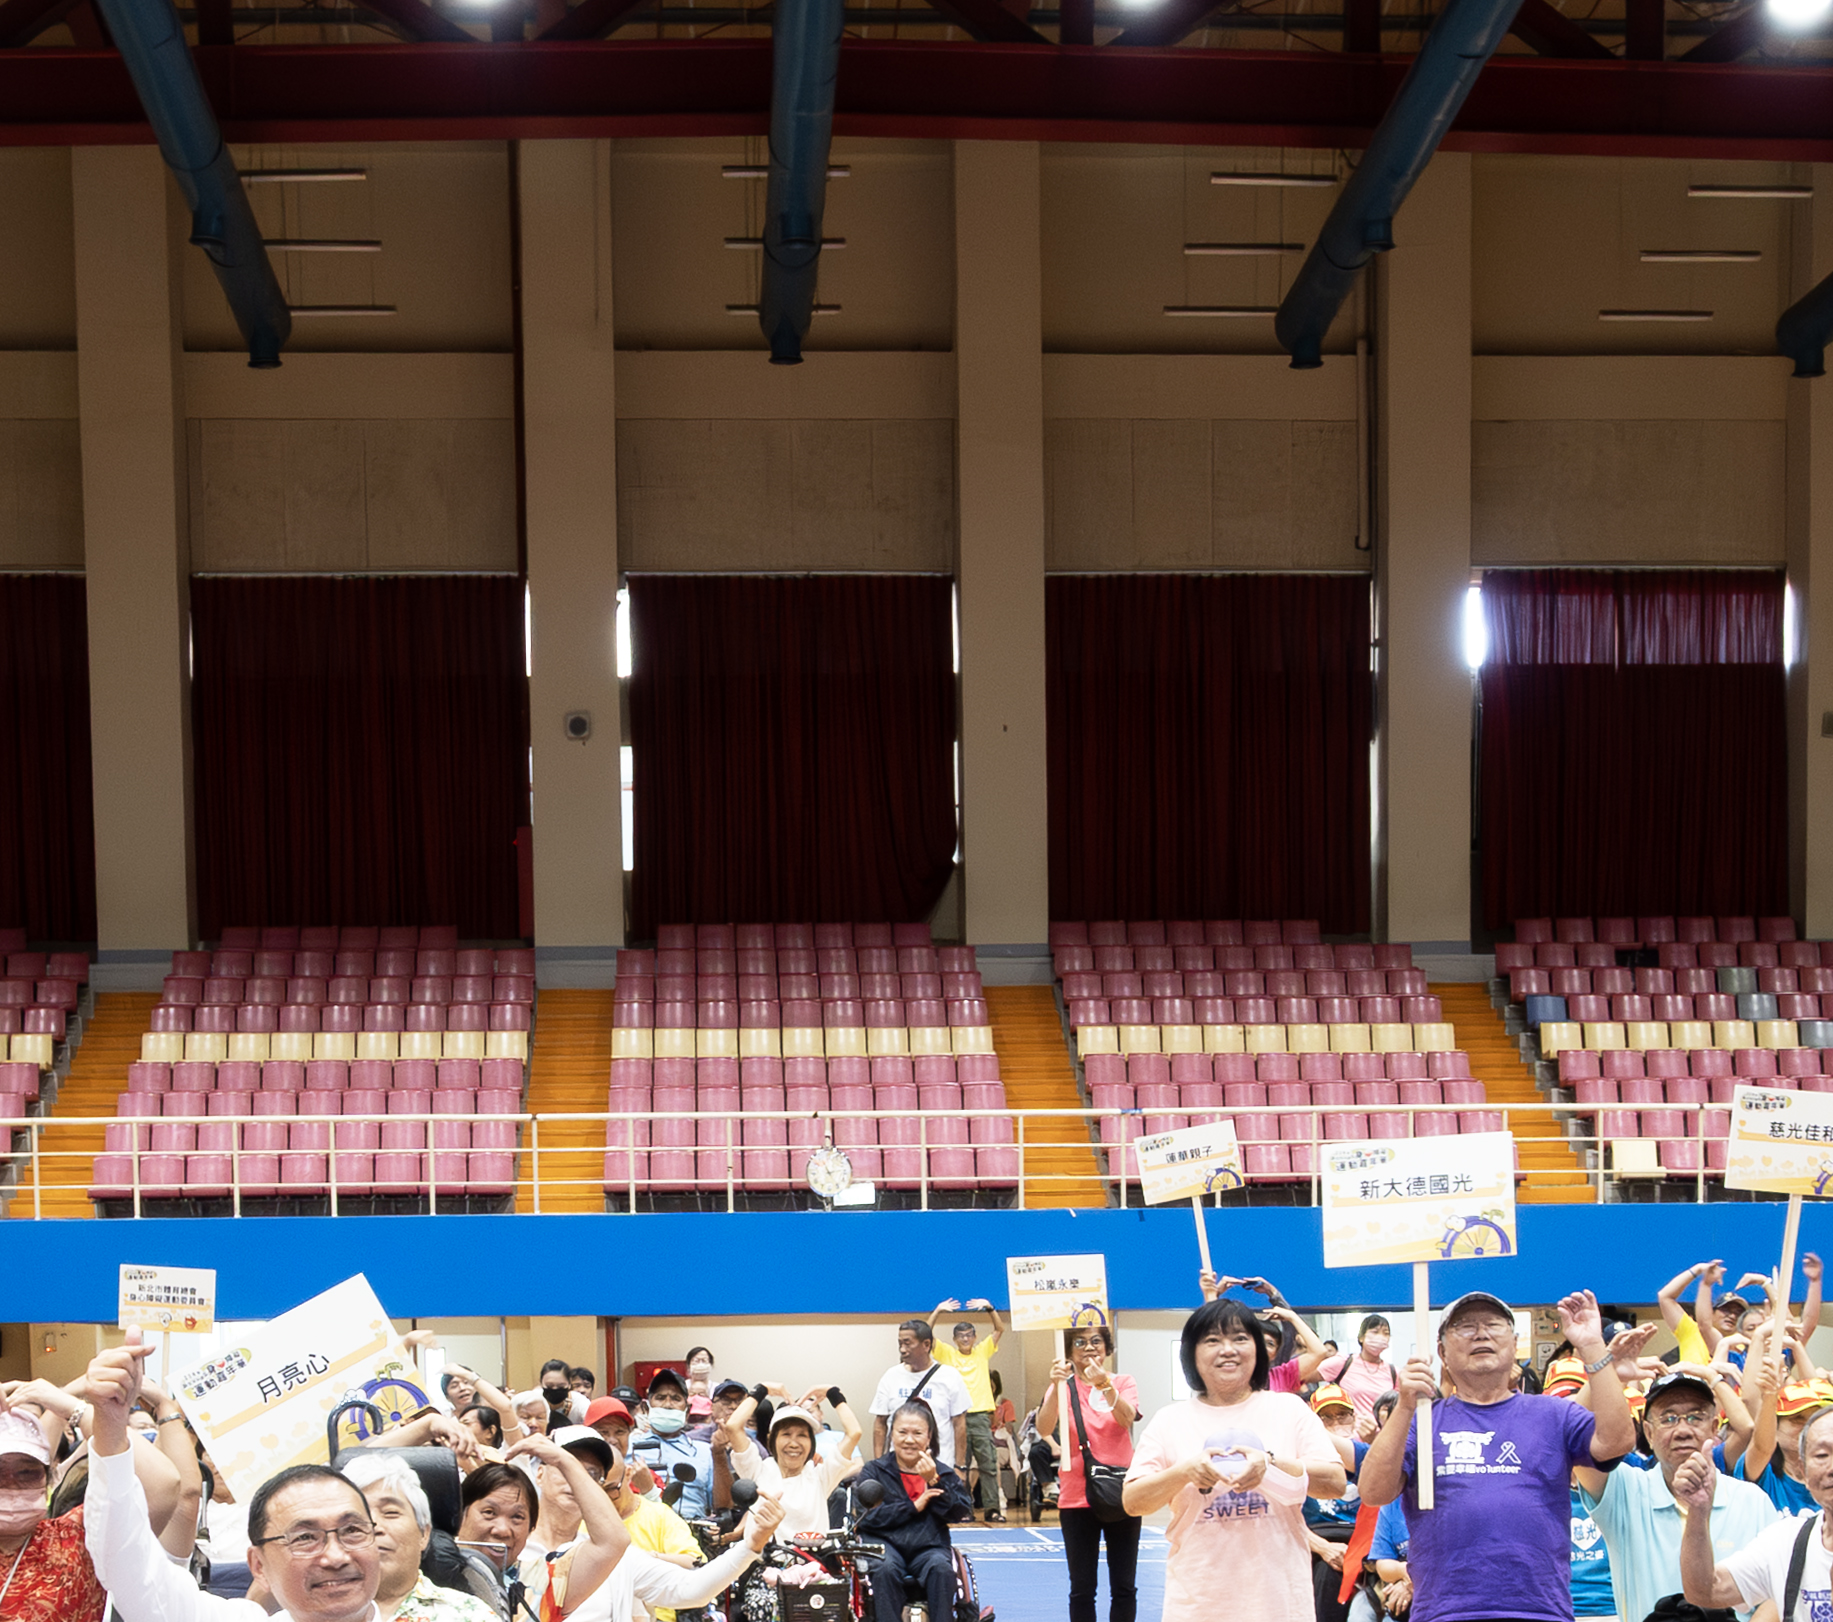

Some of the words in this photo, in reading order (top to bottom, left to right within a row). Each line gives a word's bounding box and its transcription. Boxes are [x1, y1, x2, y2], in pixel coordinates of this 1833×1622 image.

[1359, 1173, 1474, 1200] 新大德國光
[256, 1353, 330, 1403] 月亮心
[1203, 1502, 1269, 1519] SWEET
